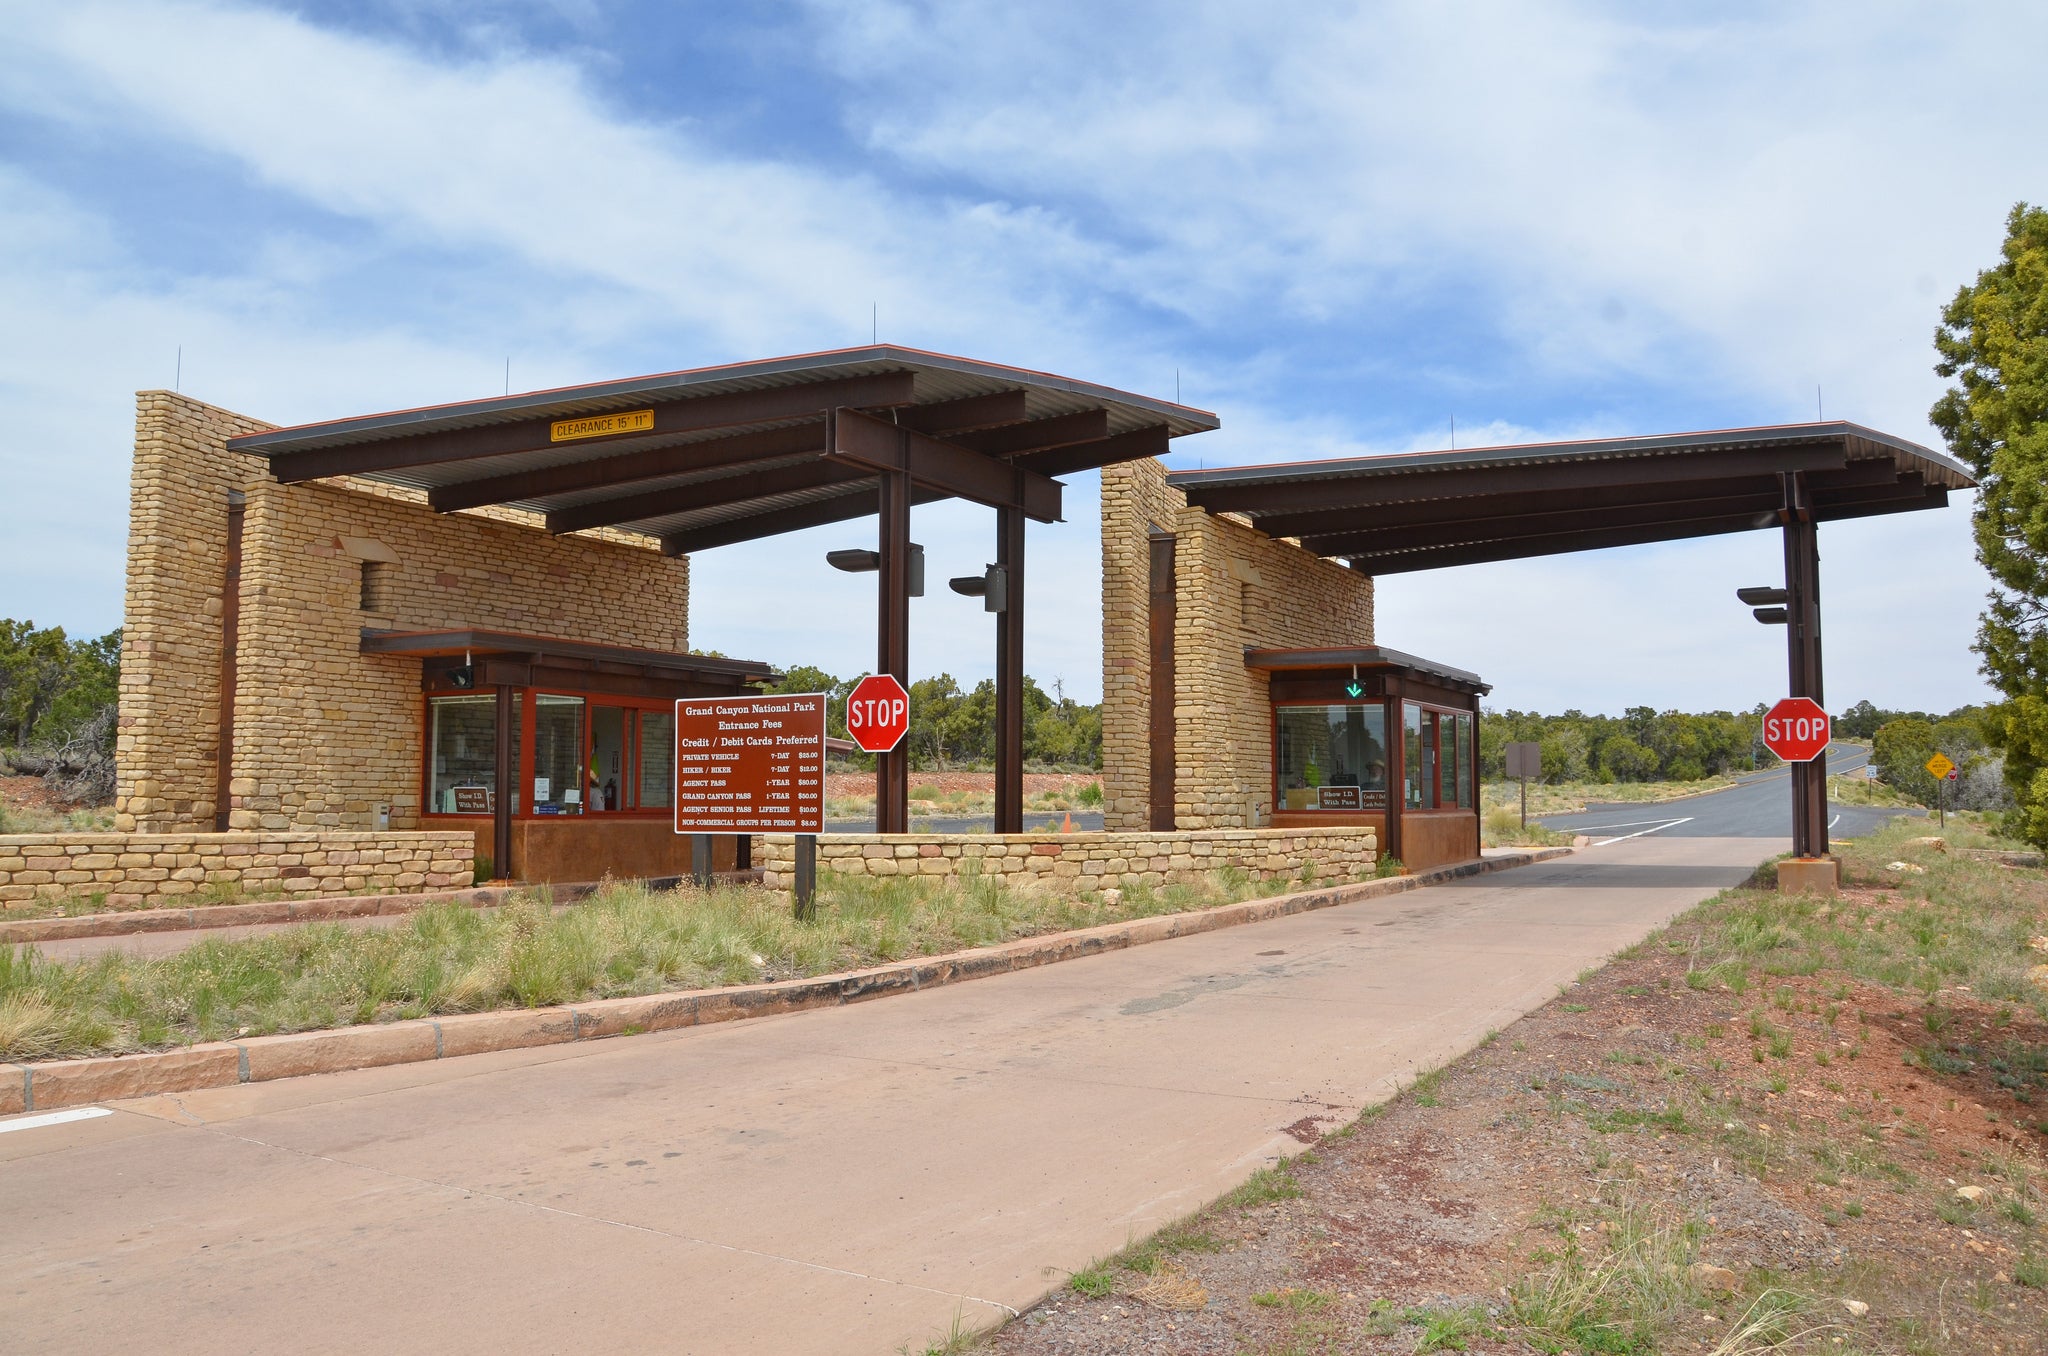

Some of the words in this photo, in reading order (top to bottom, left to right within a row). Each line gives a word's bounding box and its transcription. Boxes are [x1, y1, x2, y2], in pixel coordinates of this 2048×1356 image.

[557, 419, 612, 436] CLEARANCE
[617, 417, 630, 428] 15'
[635, 414, 647, 426] 11"
[686, 707, 713, 715] Grand
[716, 705, 749, 716] Canyon
[752, 704, 790, 713] National
[794, 702, 815, 712] Park
[852, 699, 904, 728] STOP
[719, 721, 759, 730] Entrance
[763, 720, 782, 729] Fees
[1768, 718, 1825, 741] STOP
[682, 738, 709, 747] Credit
[713, 737, 717, 747] /
[721, 737, 744, 746] Debit
[747, 736, 772, 746] Cards
[776, 735, 818, 745] Preferred
[705, 766, 709, 774] /
